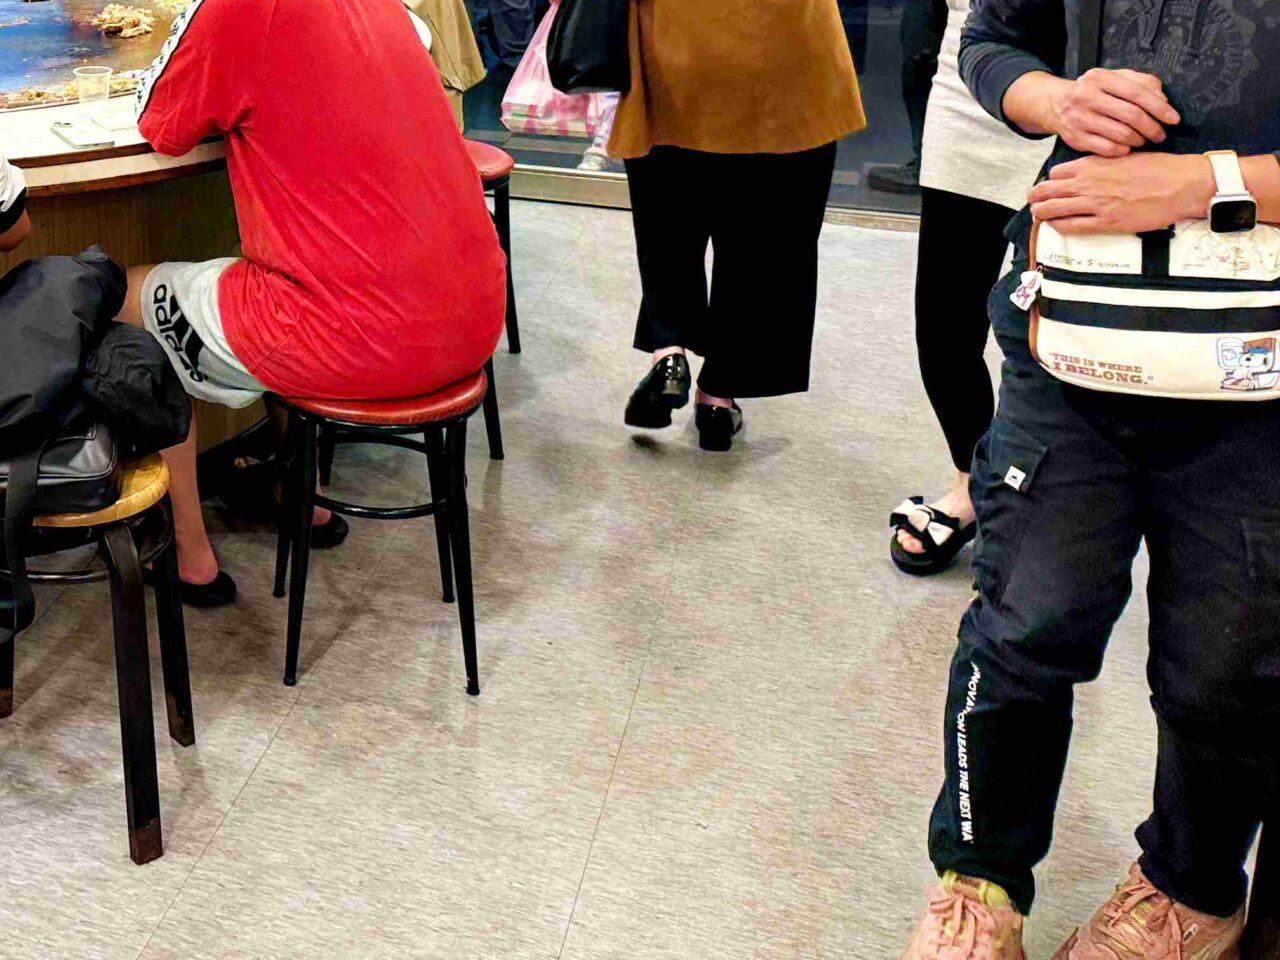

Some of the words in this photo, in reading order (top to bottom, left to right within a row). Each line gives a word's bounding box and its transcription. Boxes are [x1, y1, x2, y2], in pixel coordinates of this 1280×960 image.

[1053, 362, 1061, 371] I
[1083, 358, 1095, 367] IS
[1097, 361, 1142, 374] WHERE
[957, 732, 969, 769] LEADS
[959, 769, 970, 792] THE
[959, 791, 972, 819] NEXT
